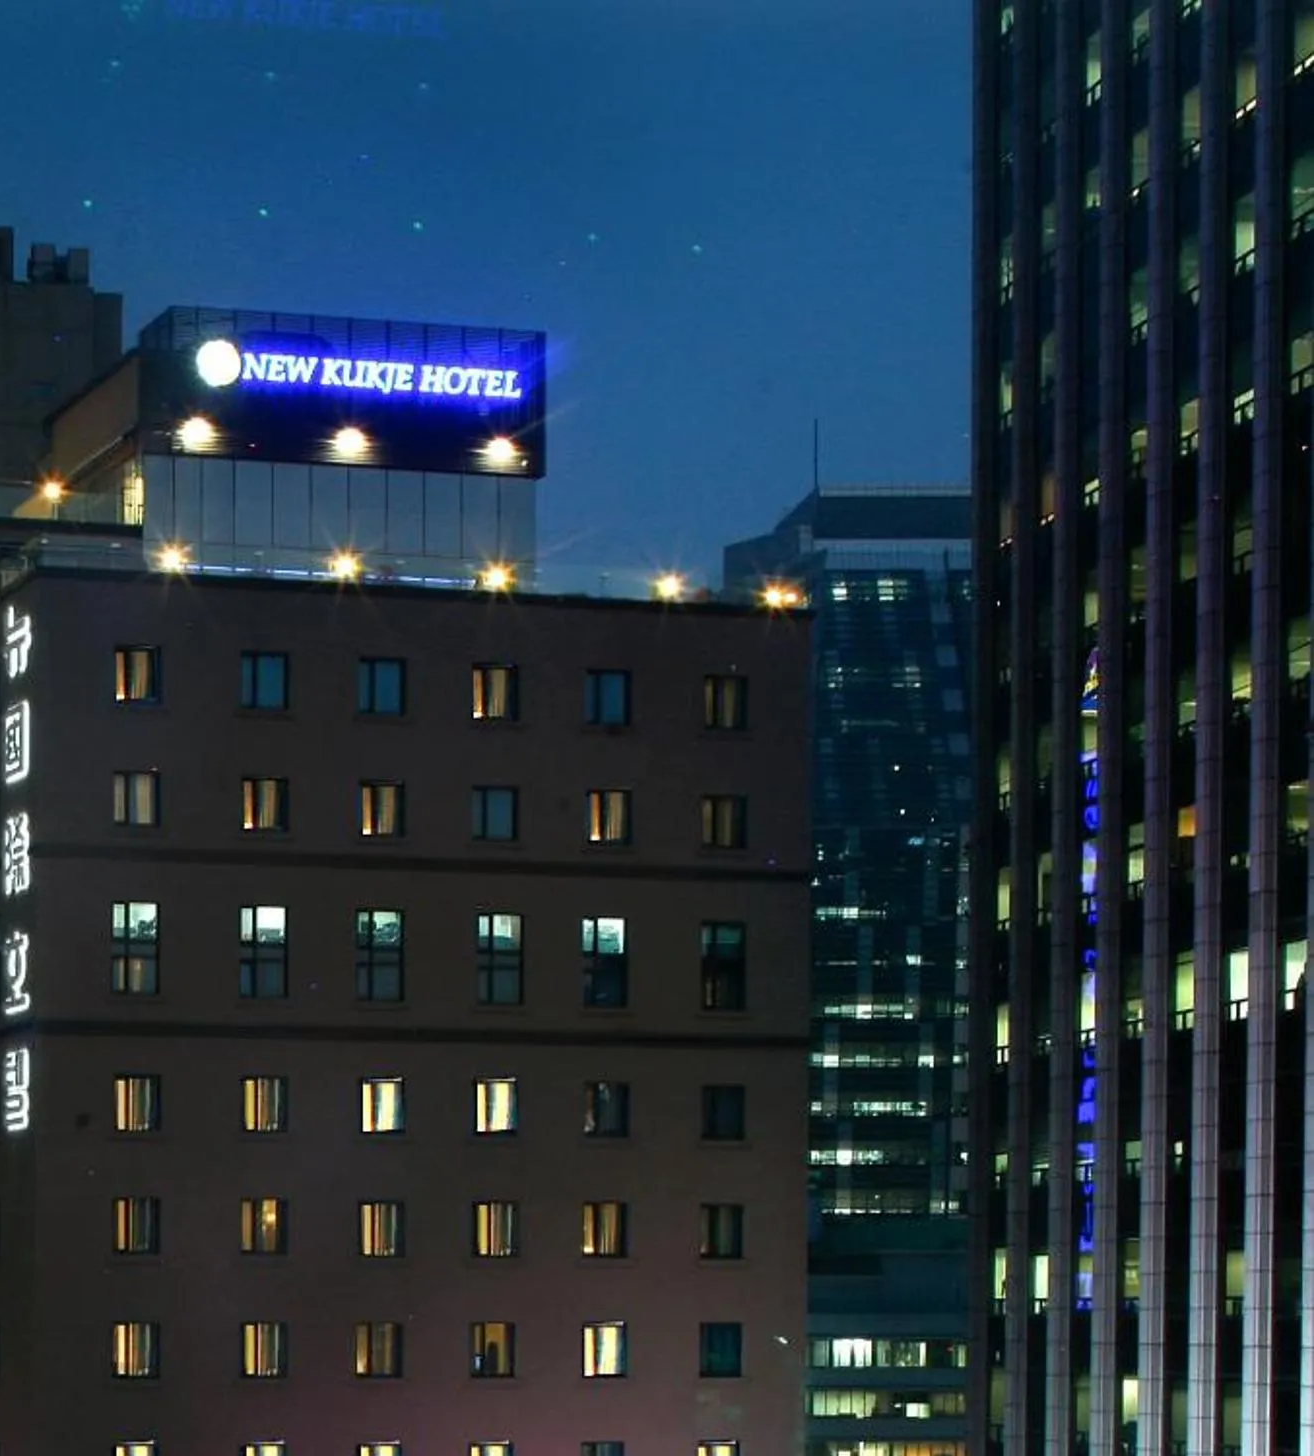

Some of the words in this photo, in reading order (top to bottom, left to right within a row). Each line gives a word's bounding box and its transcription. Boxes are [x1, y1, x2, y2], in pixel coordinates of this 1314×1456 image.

[242, 352, 318, 384] NEW
[320, 358, 413, 395] KUKJE
[418, 364, 522, 399] HOTEL
